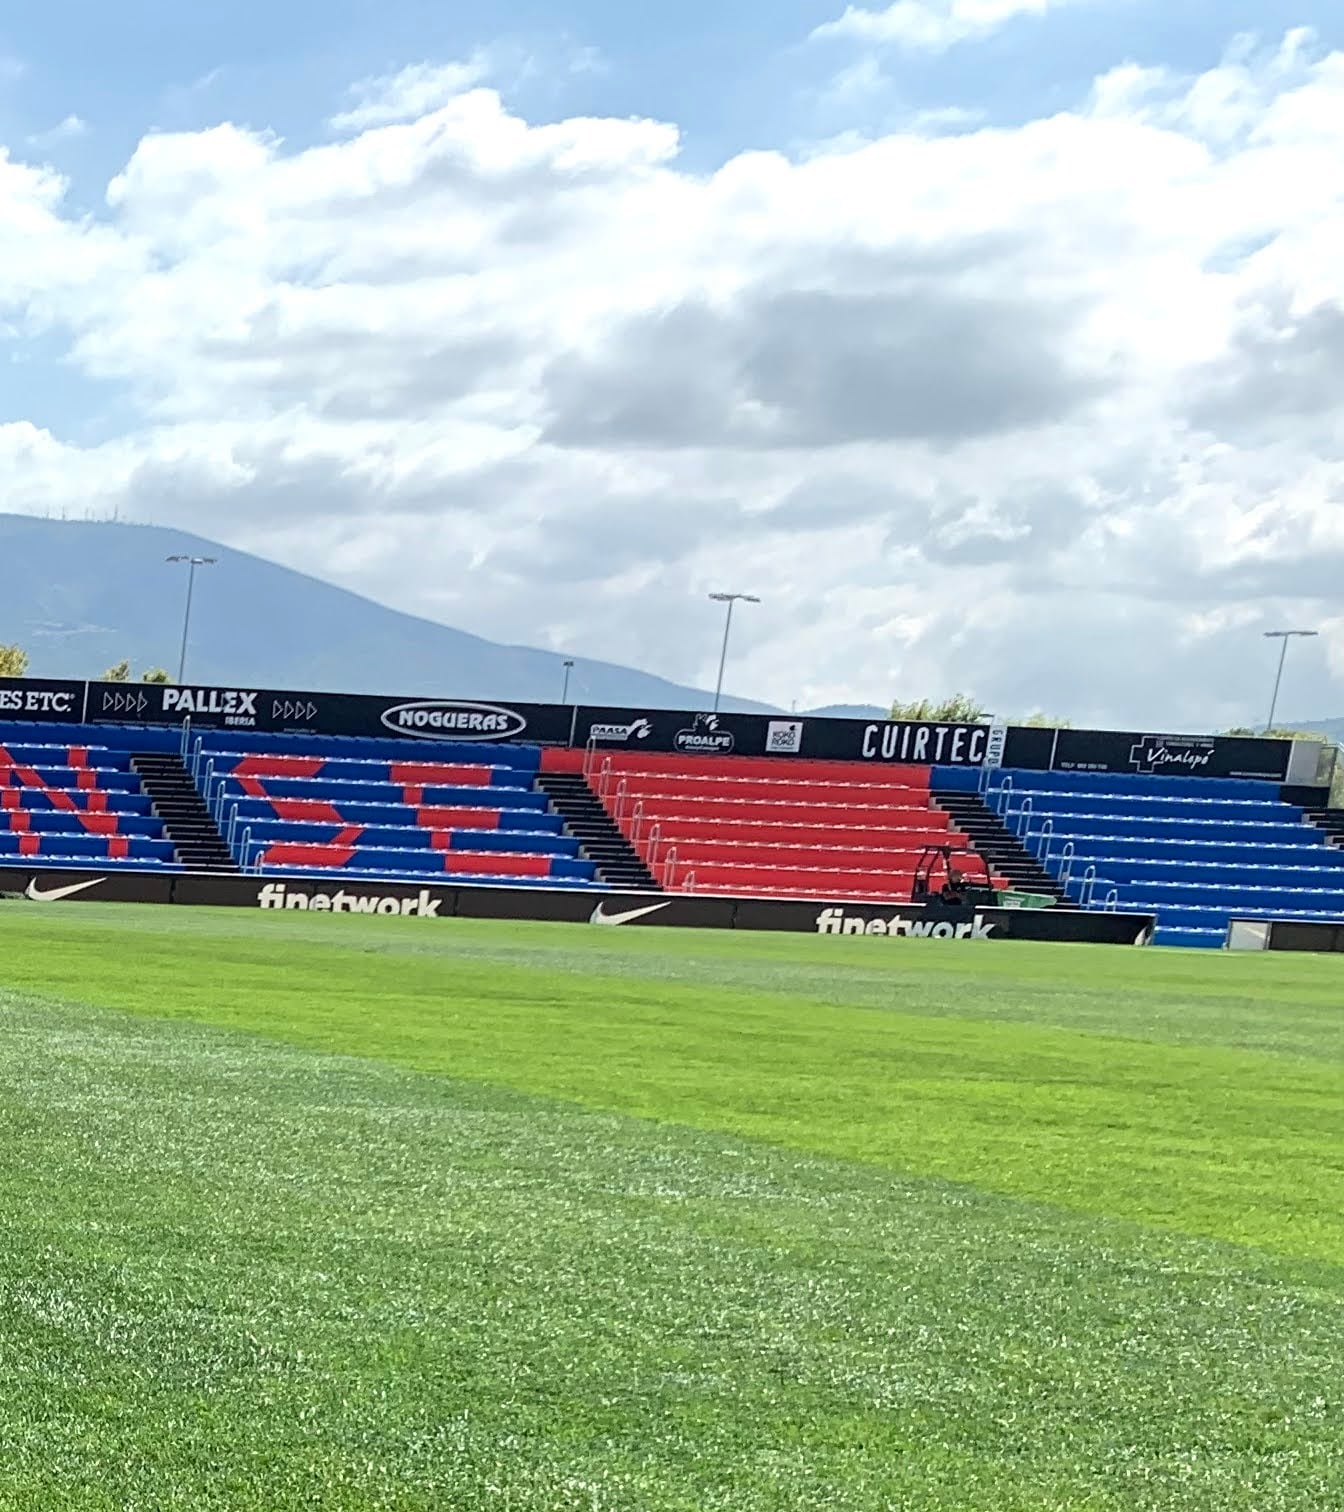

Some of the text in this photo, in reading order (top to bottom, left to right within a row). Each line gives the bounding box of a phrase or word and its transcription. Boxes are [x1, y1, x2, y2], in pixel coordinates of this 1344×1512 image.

[224, 716, 256, 727] IBERIA
[398, 710, 508, 731] NOGUERAS
[678, 734, 730, 747] PROALPE
[862, 724, 985, 762] CUIRTEC
[257, 883, 442, 917] finetwork
[816, 908, 997, 939] finetwork
